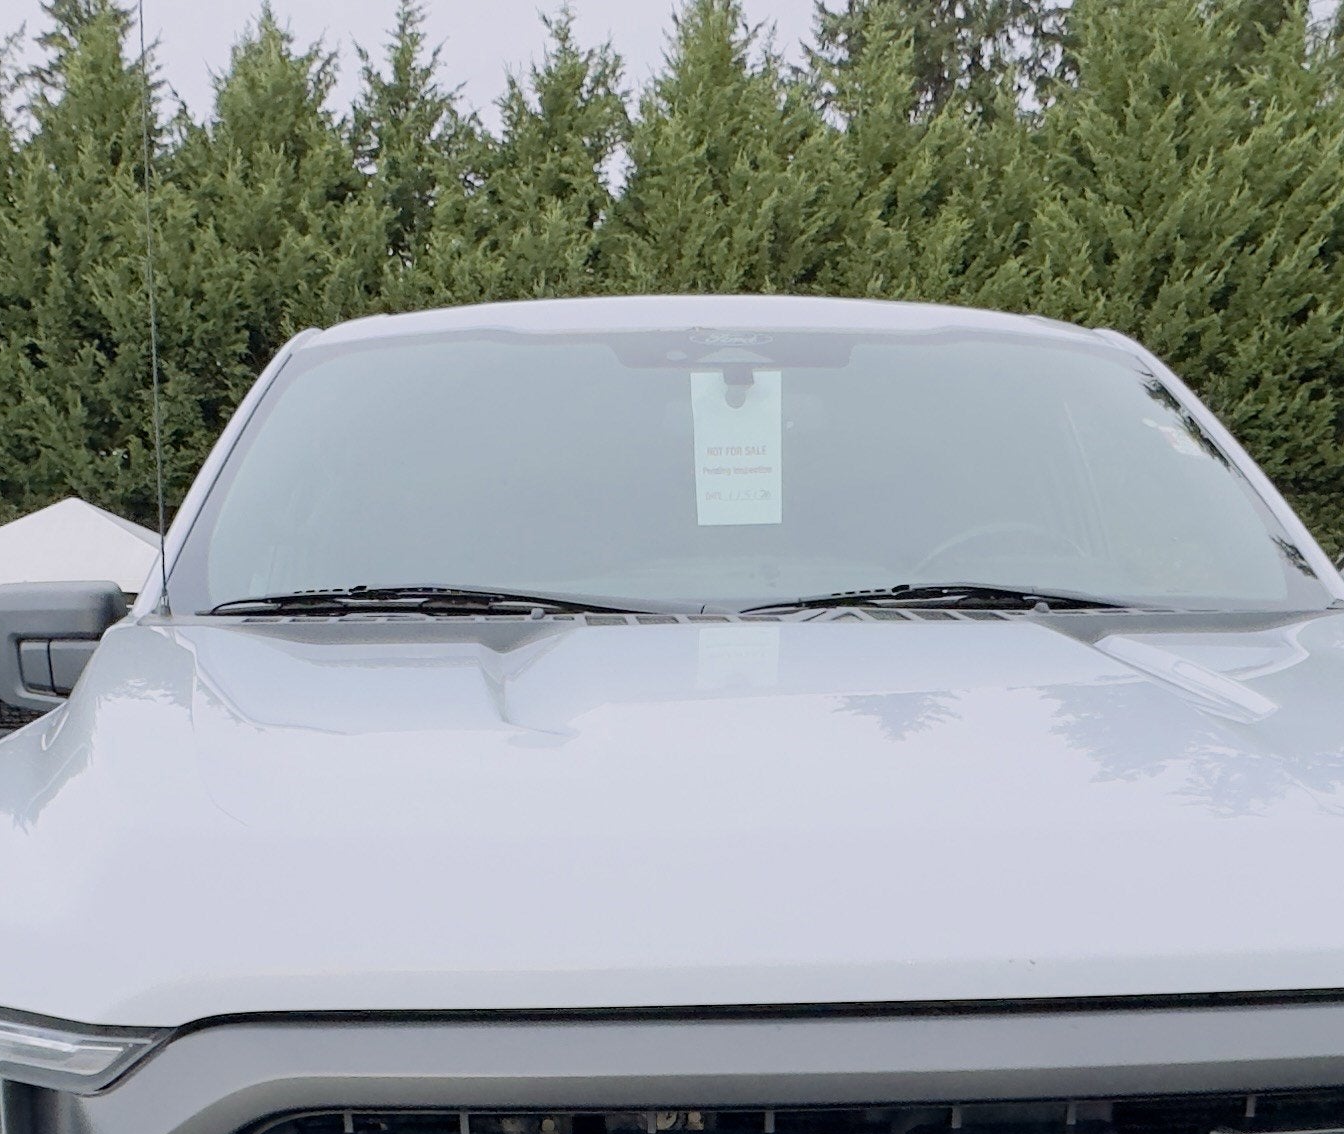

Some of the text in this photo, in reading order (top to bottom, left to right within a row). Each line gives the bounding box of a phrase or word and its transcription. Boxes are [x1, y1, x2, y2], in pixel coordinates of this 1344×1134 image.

[706, 445, 767, 456] NOT FOR SALE
